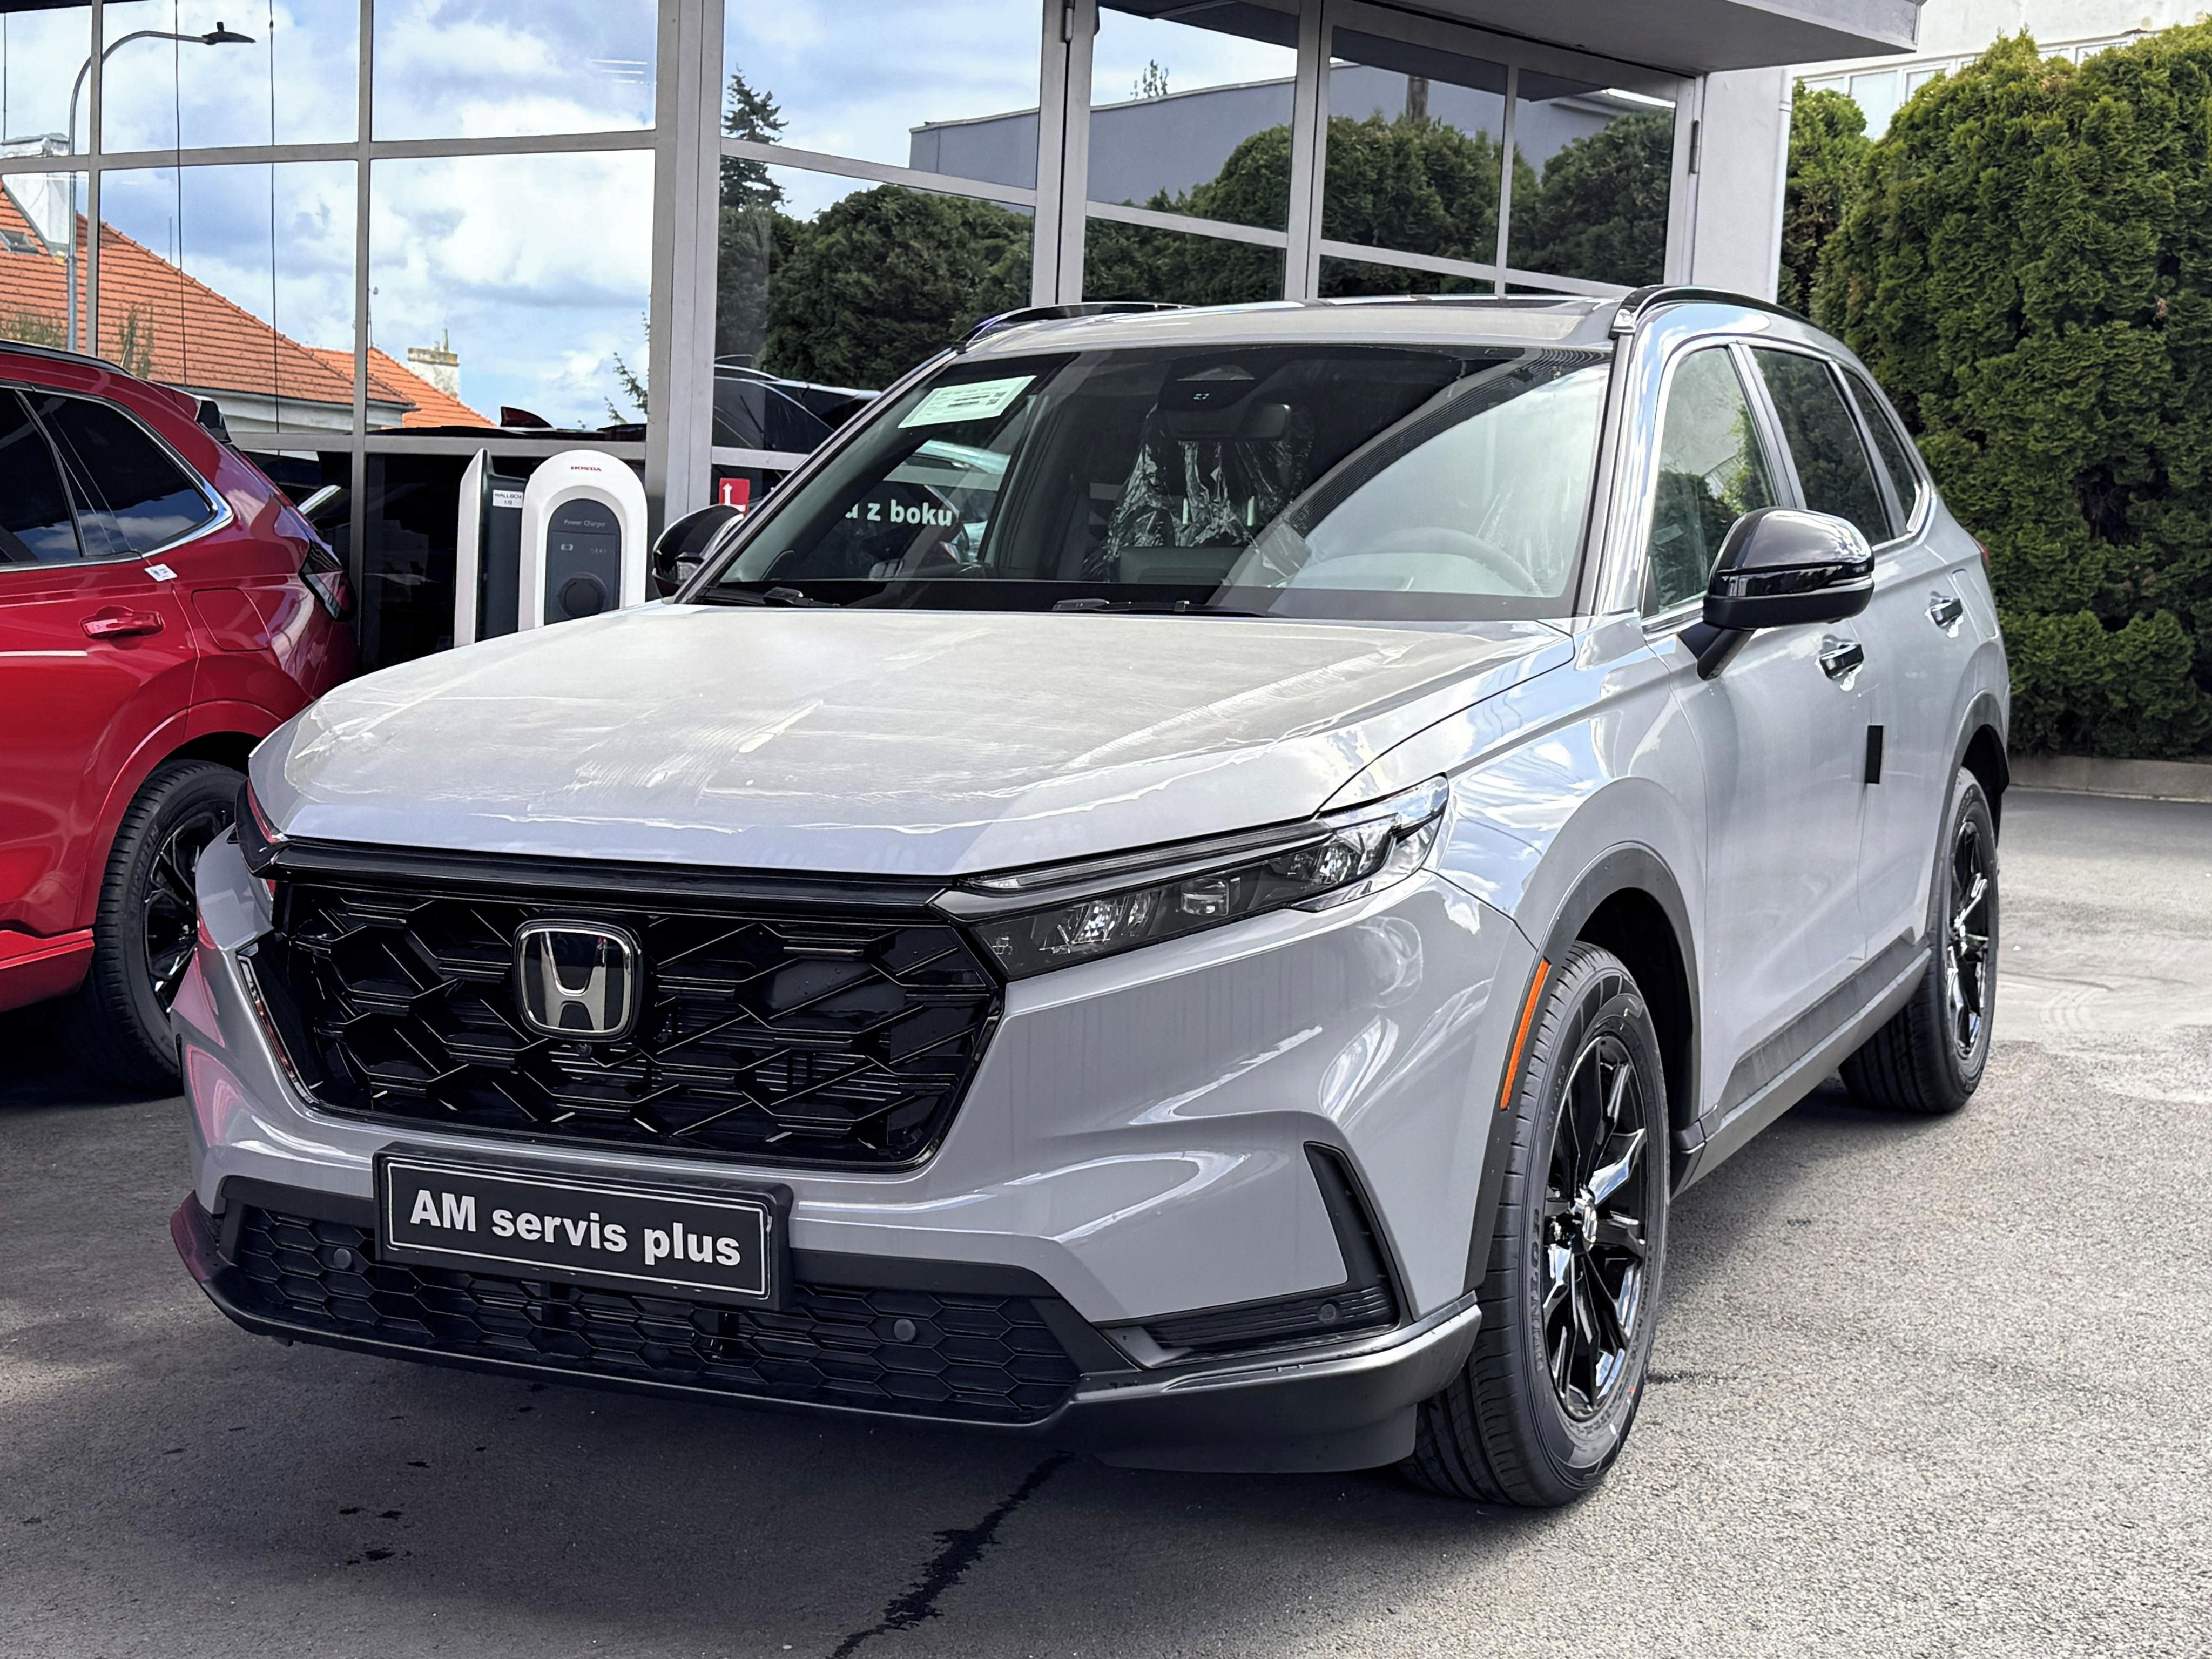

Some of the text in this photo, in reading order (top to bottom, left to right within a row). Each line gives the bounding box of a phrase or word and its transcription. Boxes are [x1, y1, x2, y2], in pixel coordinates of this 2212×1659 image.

[583, 520, 606, 528] Charger
[867, 502, 881, 521] z
[889, 498, 953, 527] boku
[410, 1190, 740, 1265] AM servis plus
